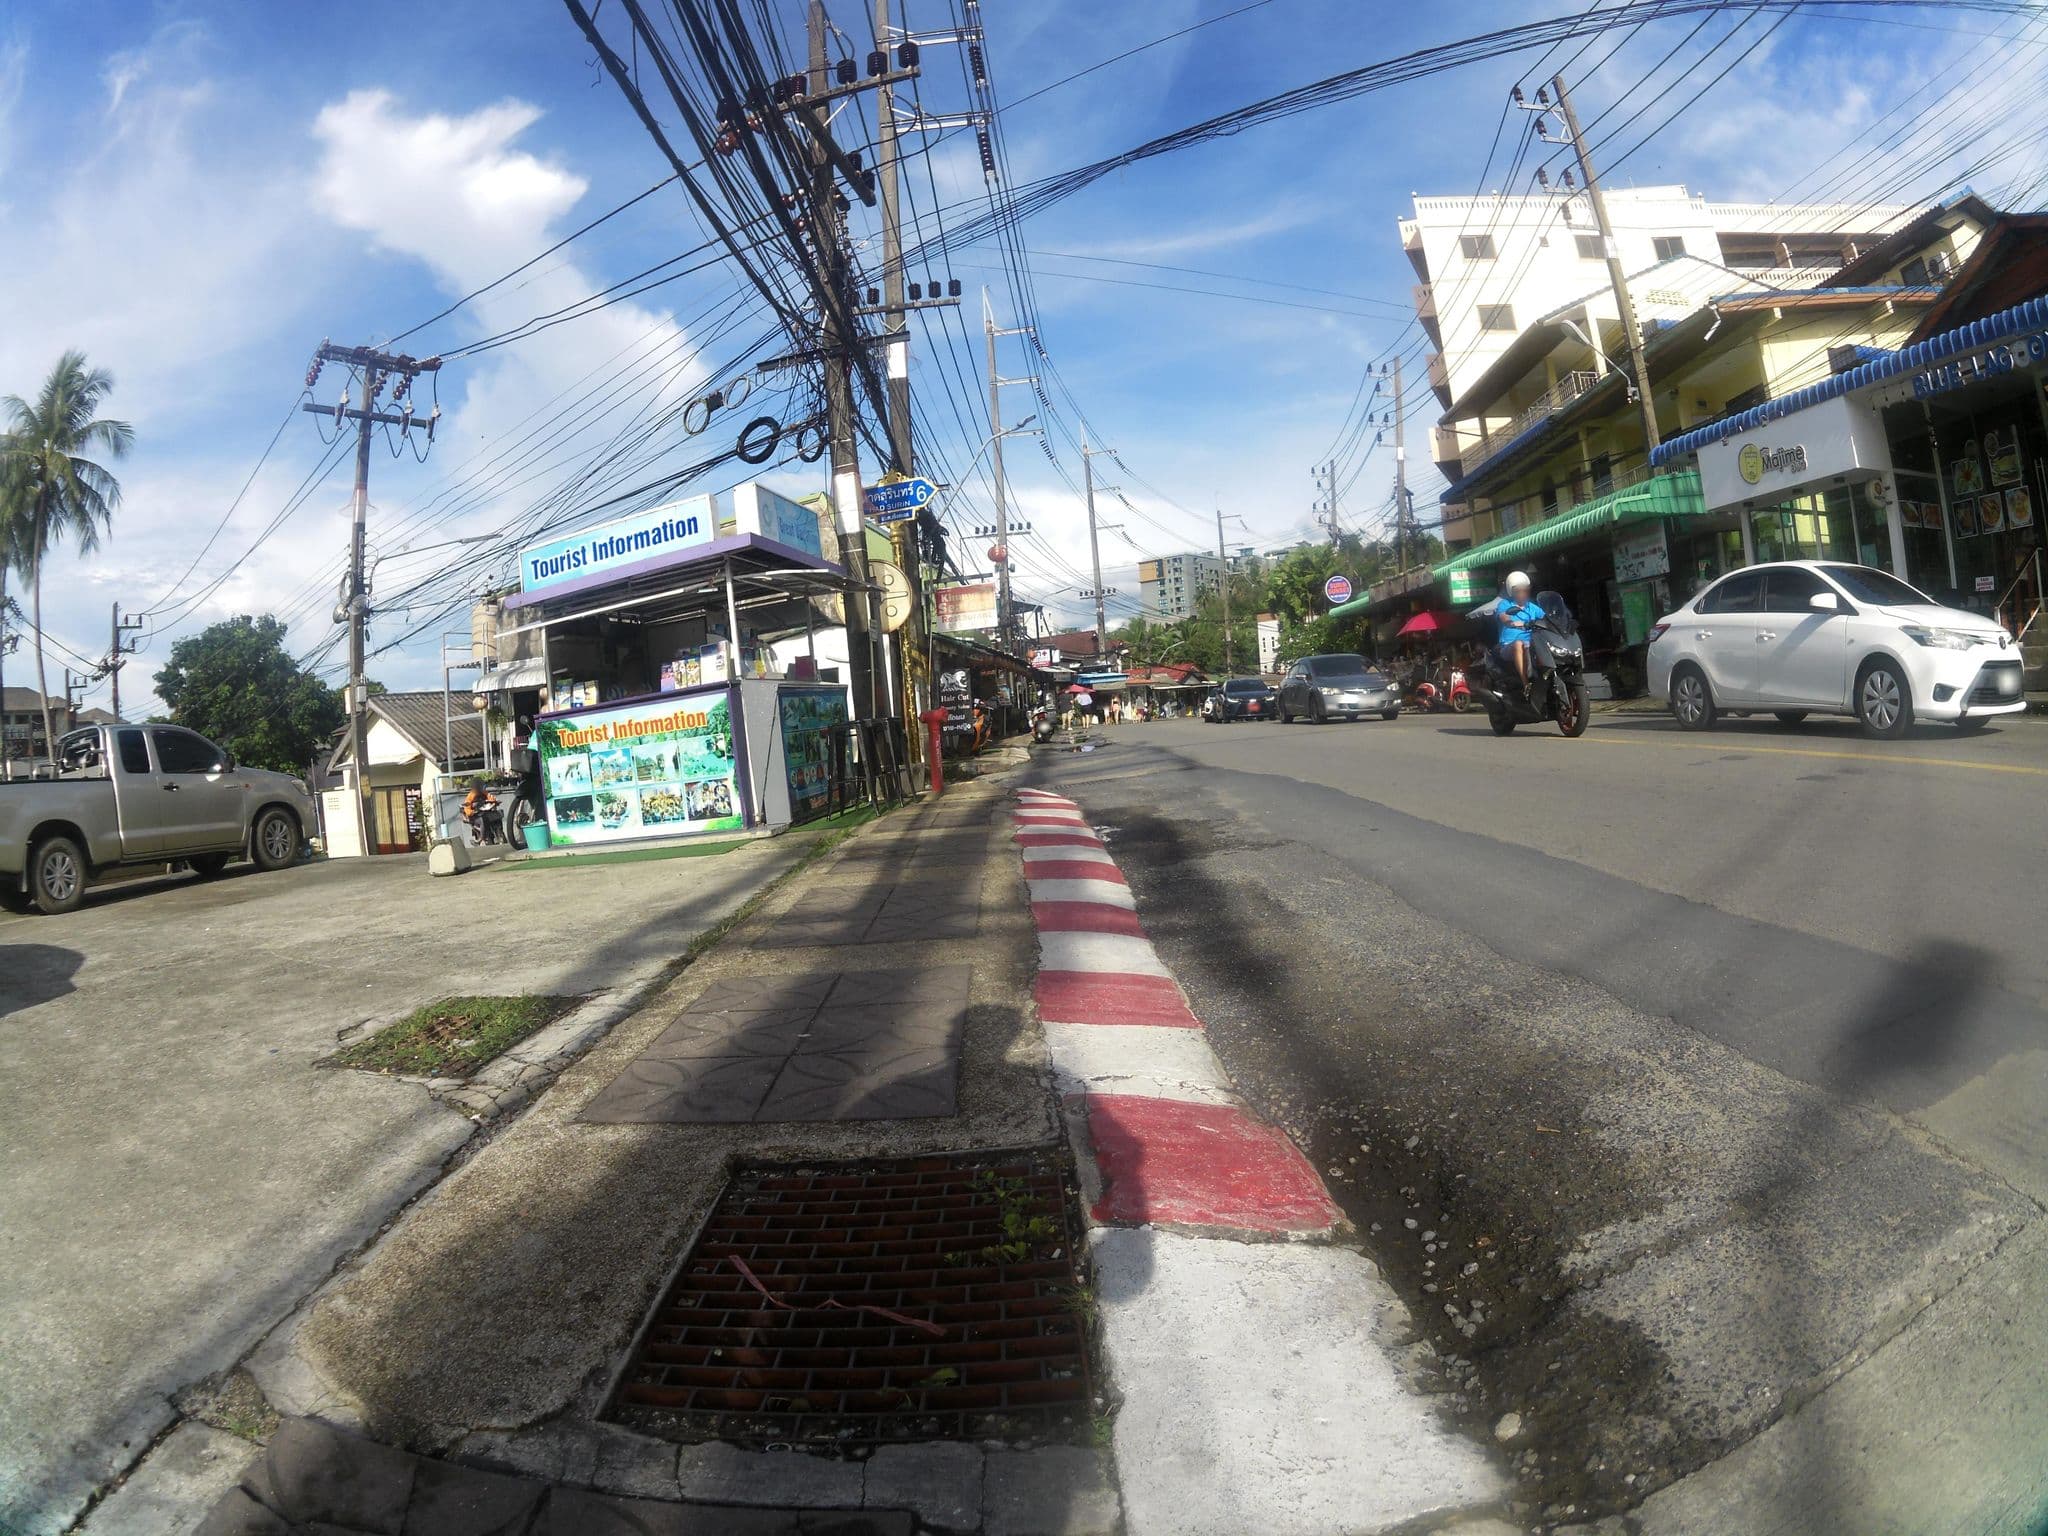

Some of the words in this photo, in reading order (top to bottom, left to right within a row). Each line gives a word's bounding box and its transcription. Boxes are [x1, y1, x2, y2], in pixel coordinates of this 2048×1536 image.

[1761, 446, 1804, 473] Majime
[867, 481, 914, 505] าดสุรินทร์
[916, 485, 927, 502] 6
[886, 501, 911, 510] SURIN
[530, 545, 588, 581] Tourist
[592, 515, 699, 562] Information
[940, 695, 956, 703] Hair
[957, 693, 970, 701] Cut
[557, 723, 610, 748] Tourist
[612, 710, 708, 739] Information
